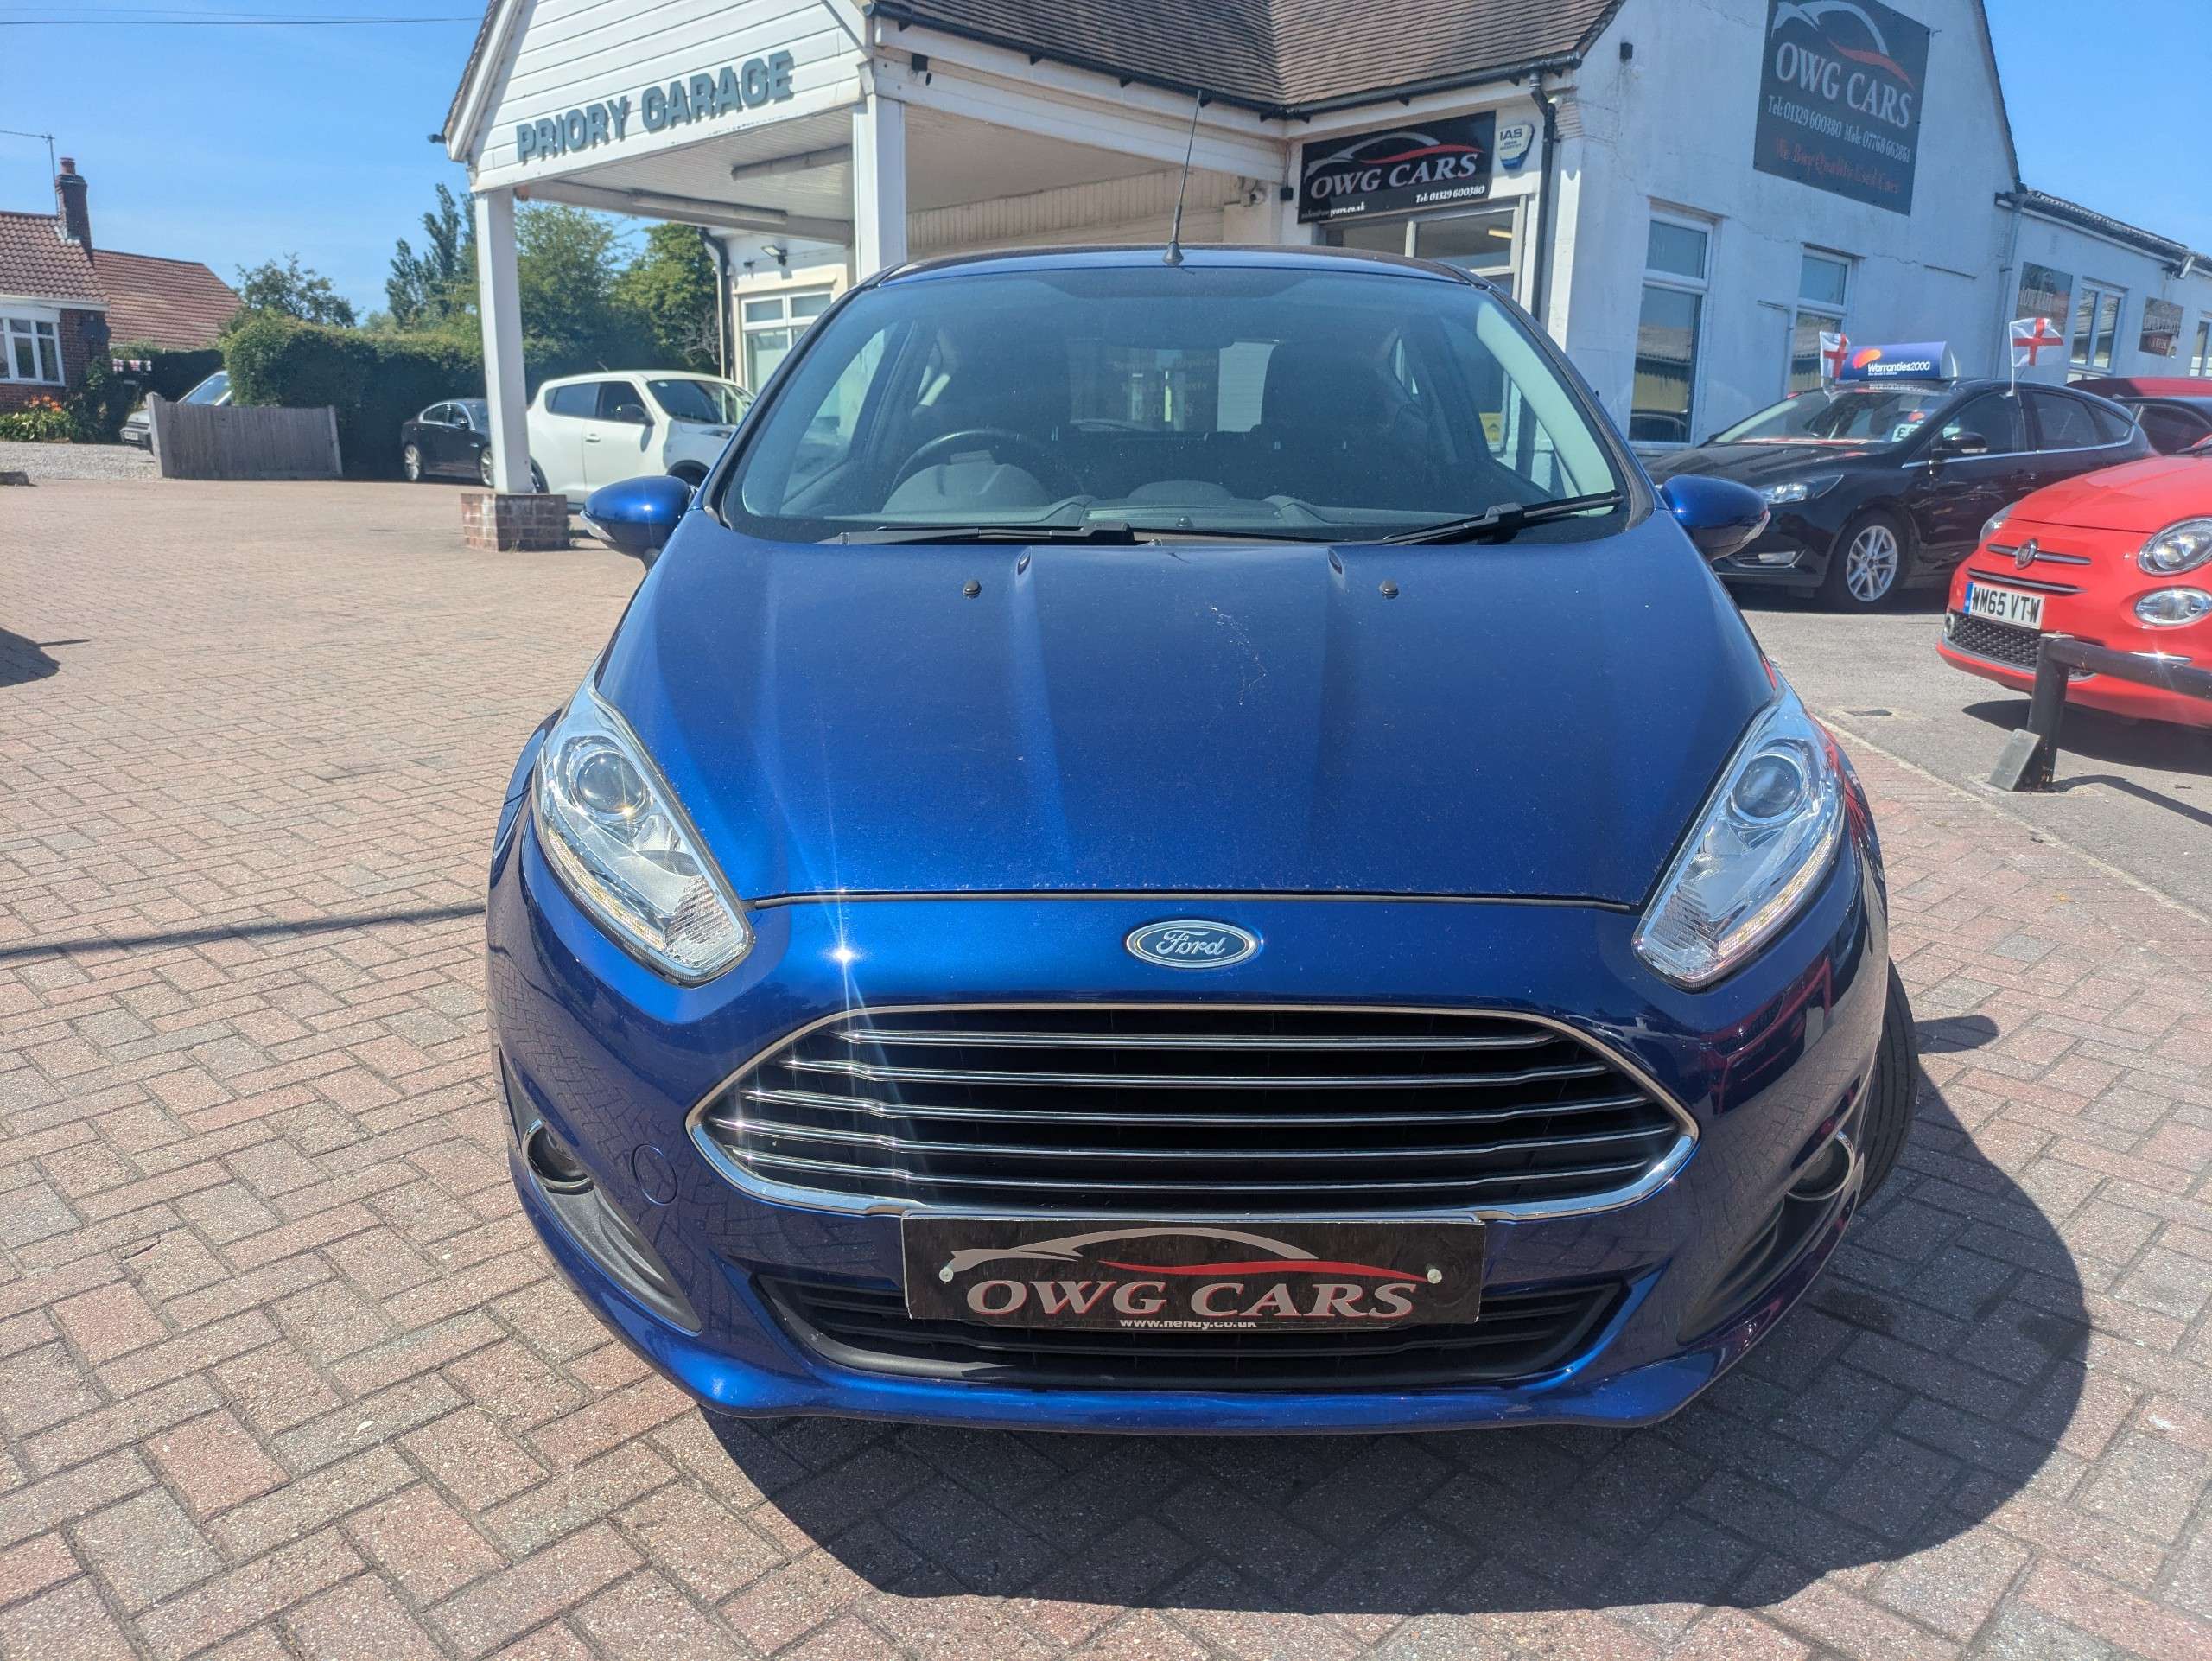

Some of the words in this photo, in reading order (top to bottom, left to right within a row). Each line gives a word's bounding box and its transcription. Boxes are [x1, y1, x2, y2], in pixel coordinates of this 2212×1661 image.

[1775, 41, 1841, 101] OWG
[1846, 72, 1913, 129] CARS
[516, 95, 632, 165] PRIORY
[641, 49, 794, 134] GARAGE
[1783, 102, 1809, 126] 01329
[1499, 128, 1522, 141] IAS
[1310, 168, 1382, 200] OWG
[1389, 153, 1478, 188] CARS
[1429, 188, 1452, 201] 01329
[1452, 184, 1485, 199] 600380
[1867, 361, 1930, 372] Warranties2000
[1972, 585, 2007, 616] WM65
[2010, 594, 2041, 623] VTW
[1156, 930, 1226, 955] Ford
[965, 1279, 1168, 1317] OWG
[1190, 1281, 1418, 1318] CARS
